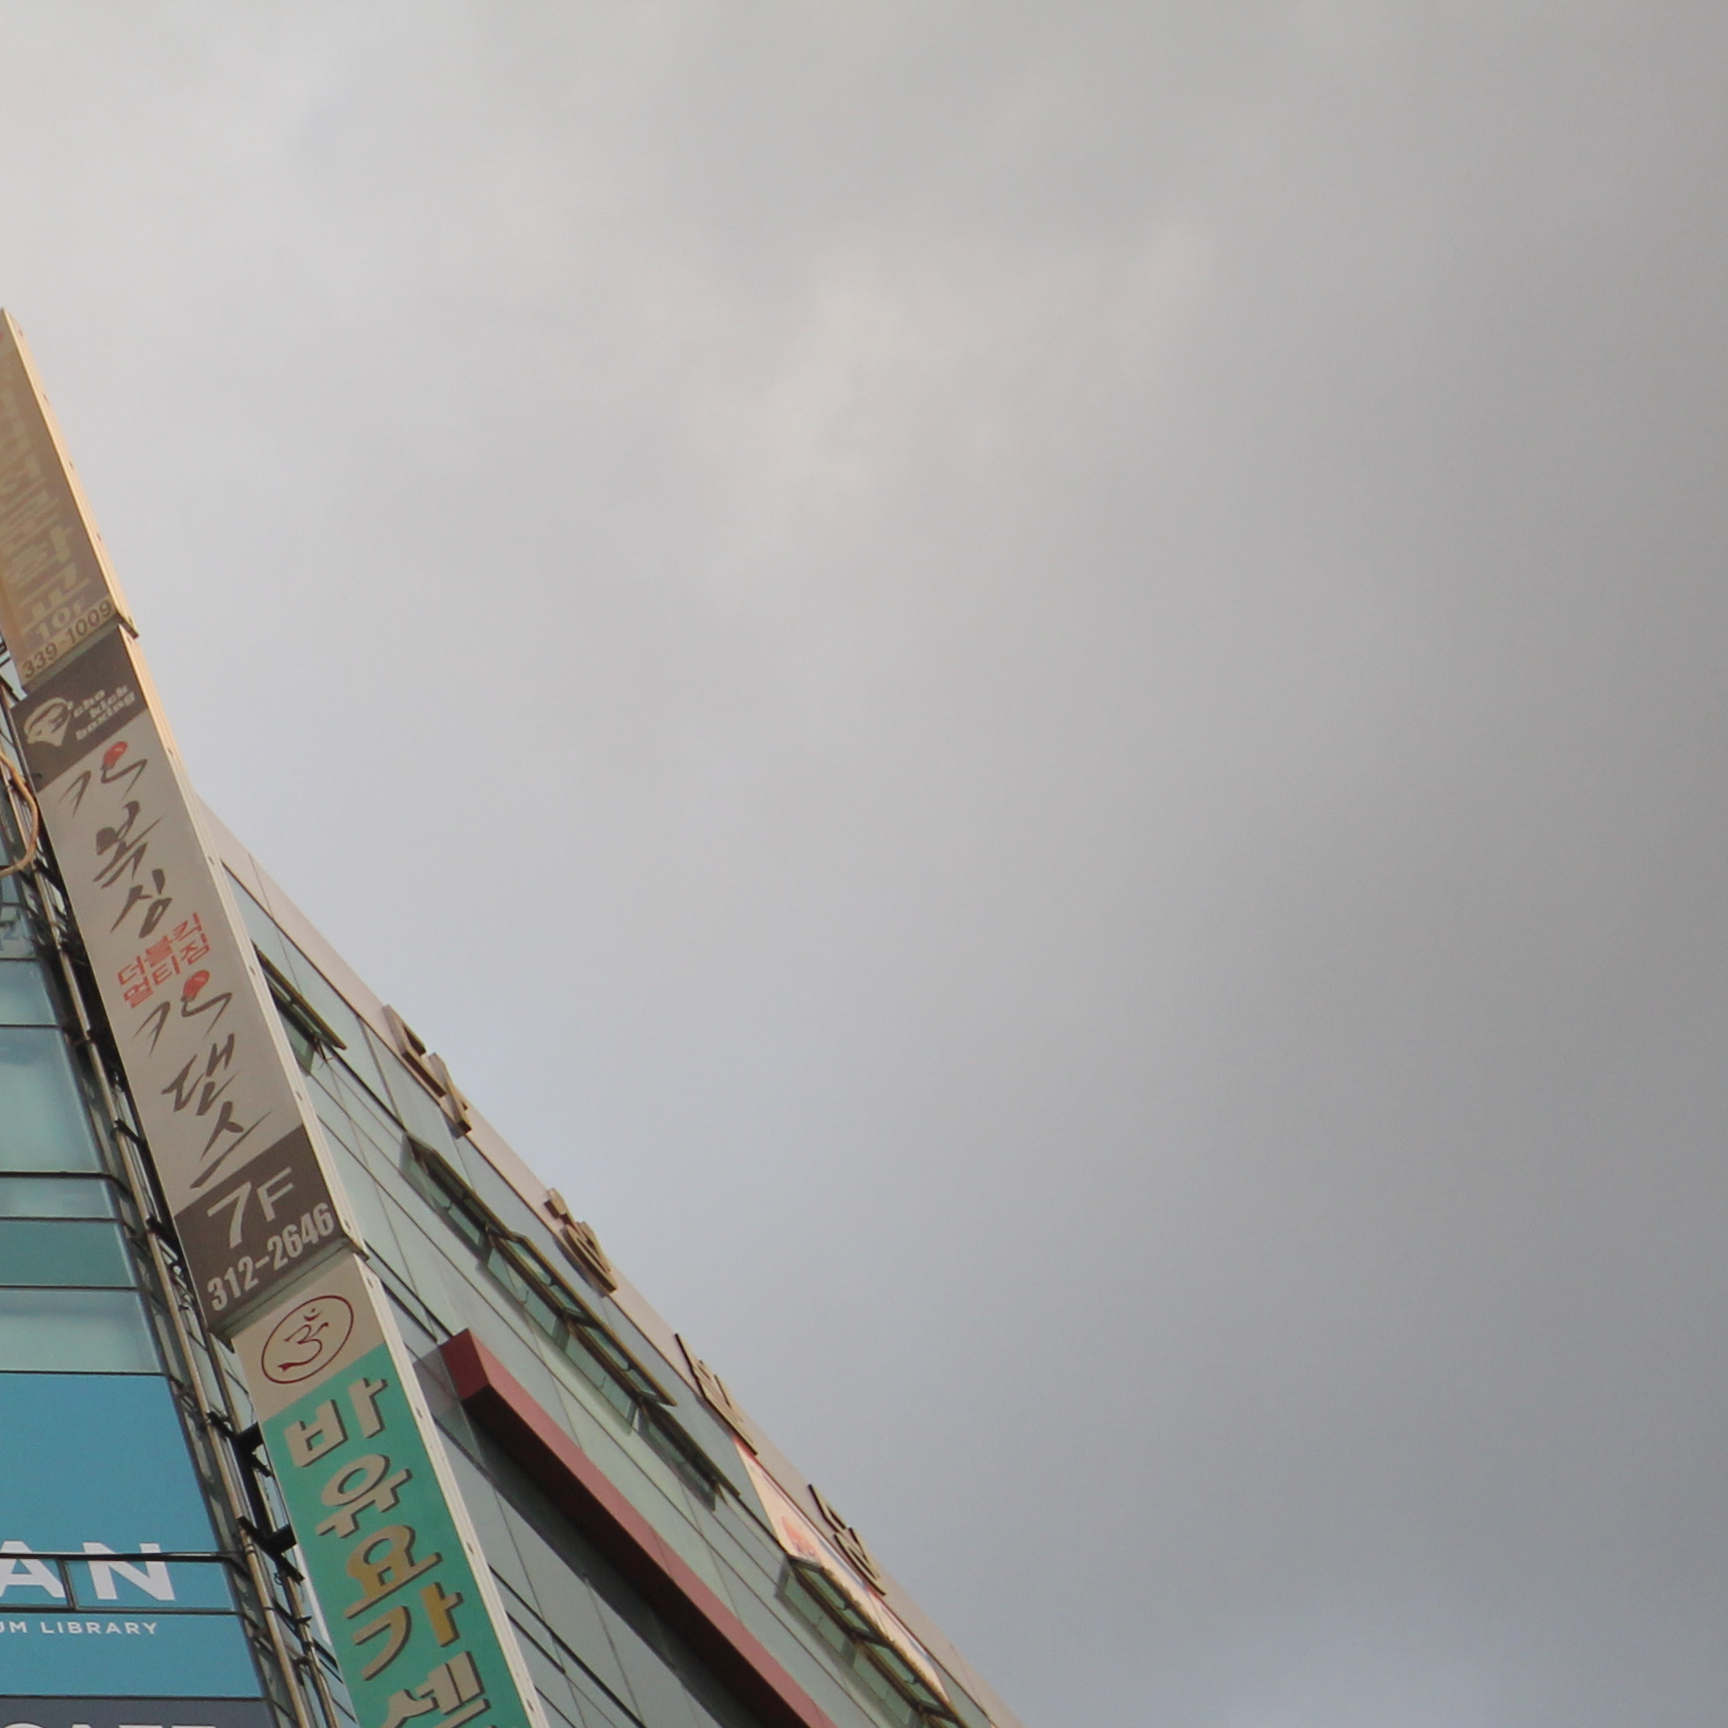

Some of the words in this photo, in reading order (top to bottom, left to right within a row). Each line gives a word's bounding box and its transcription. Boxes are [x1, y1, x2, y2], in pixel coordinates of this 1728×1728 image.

[22, 601, 113, 680] 339-1009
[207, 1166, 294, 1249] 7F
[208, 1202, 334, 1311] 312-2646
[40, 1620, 158, 1635] LIBRARY
